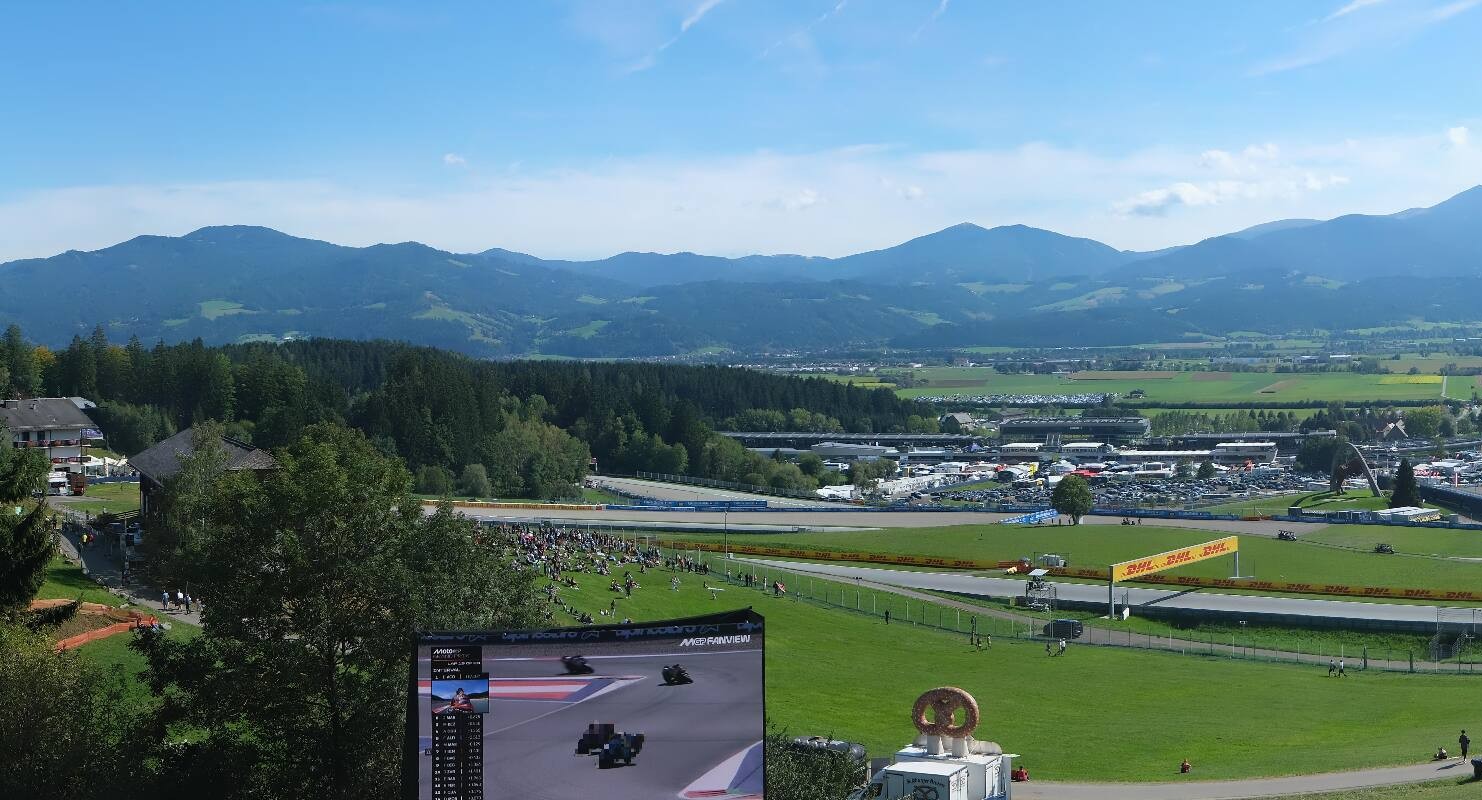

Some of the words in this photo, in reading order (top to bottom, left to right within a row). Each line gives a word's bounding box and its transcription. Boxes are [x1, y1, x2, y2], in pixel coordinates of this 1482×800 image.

[1202, 542, 1227, 557] DHL
[1166, 551, 1192, 565] DHL
[1126, 560, 1155, 575] DHL
